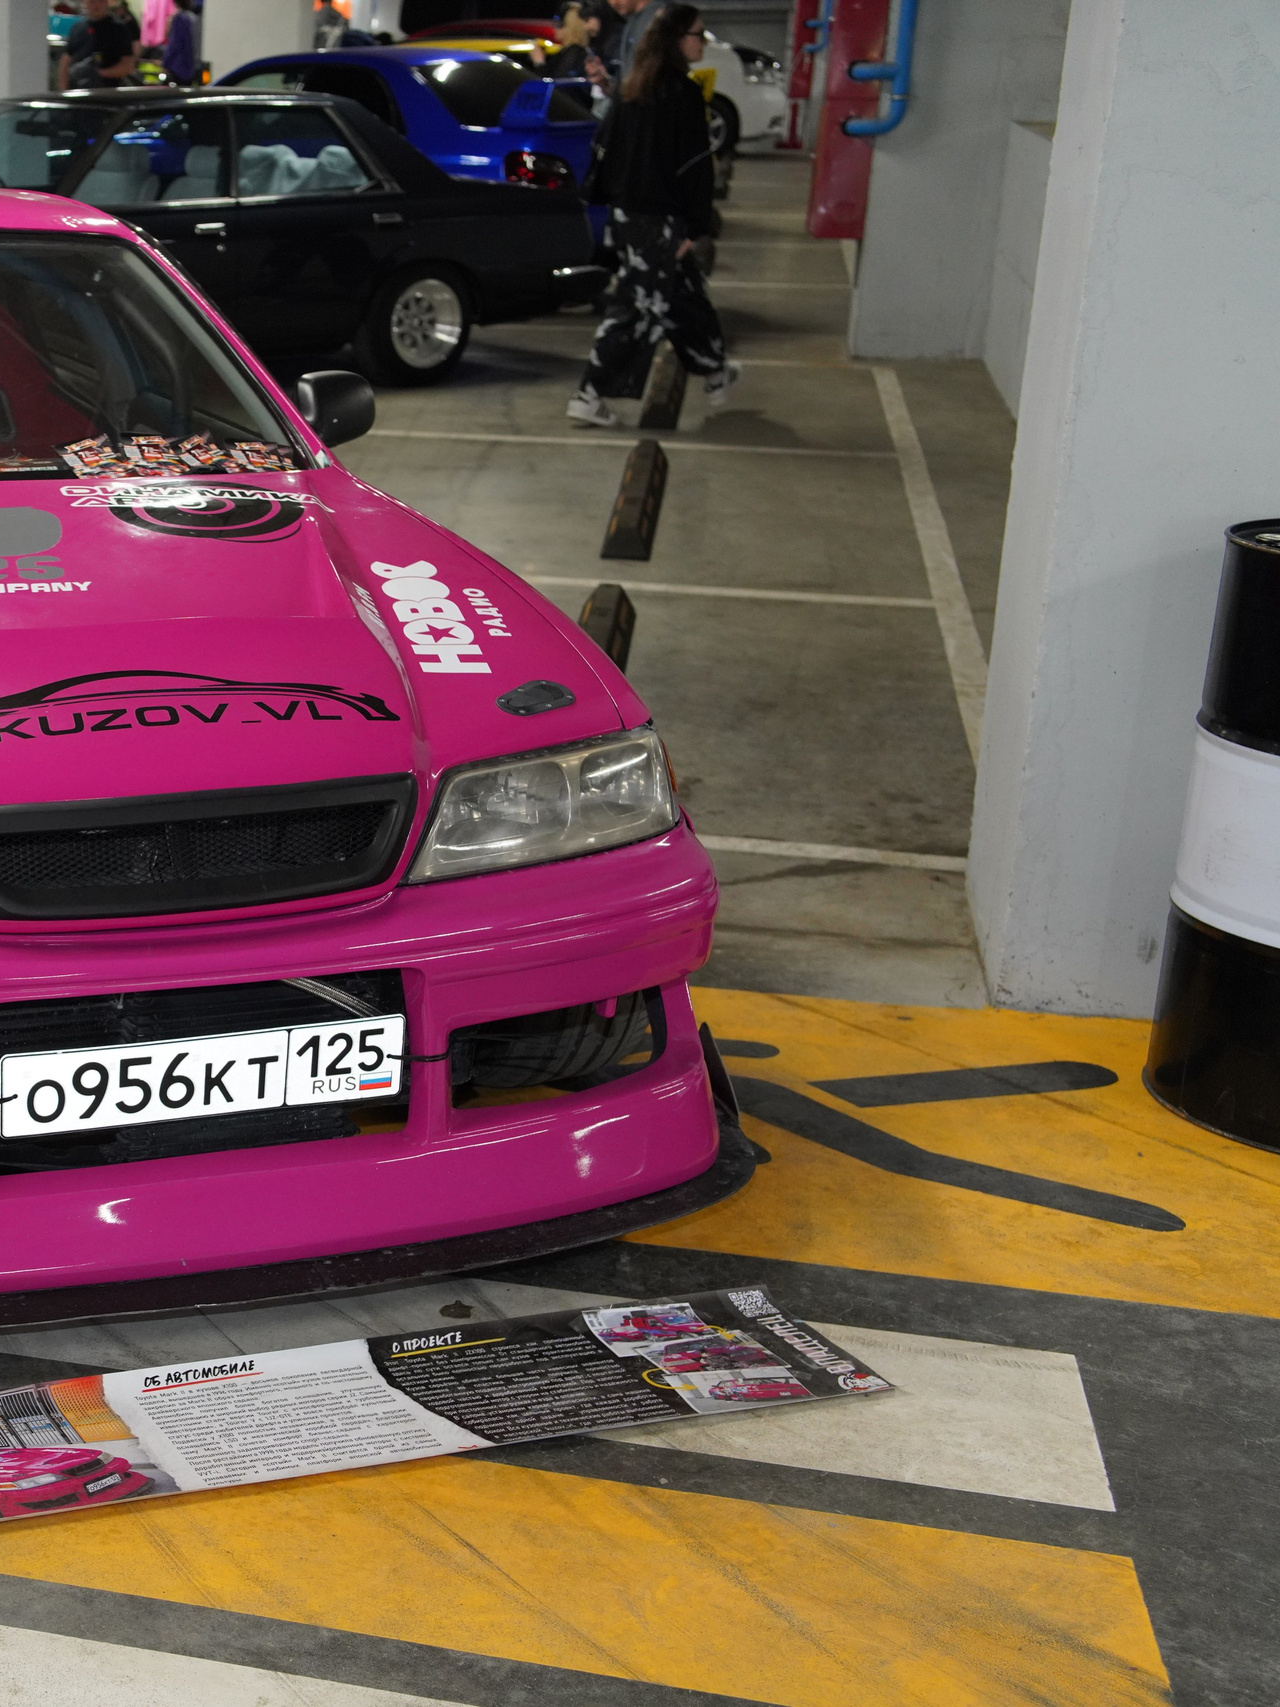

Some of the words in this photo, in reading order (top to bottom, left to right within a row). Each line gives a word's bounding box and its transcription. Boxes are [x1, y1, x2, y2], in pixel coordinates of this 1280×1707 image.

[462, 588, 512, 637] РАДИО
[296, 1028, 385, 1078] 125
[312, 1076, 357, 1094] RUS
[392, 1342, 400, 1353] О
[403, 1331, 462, 1351] ПРОЕКТЕ
[144, 1375, 161, 1388] ОБ
[165, 1360, 255, 1385] АВТОМОБИЛЕ
